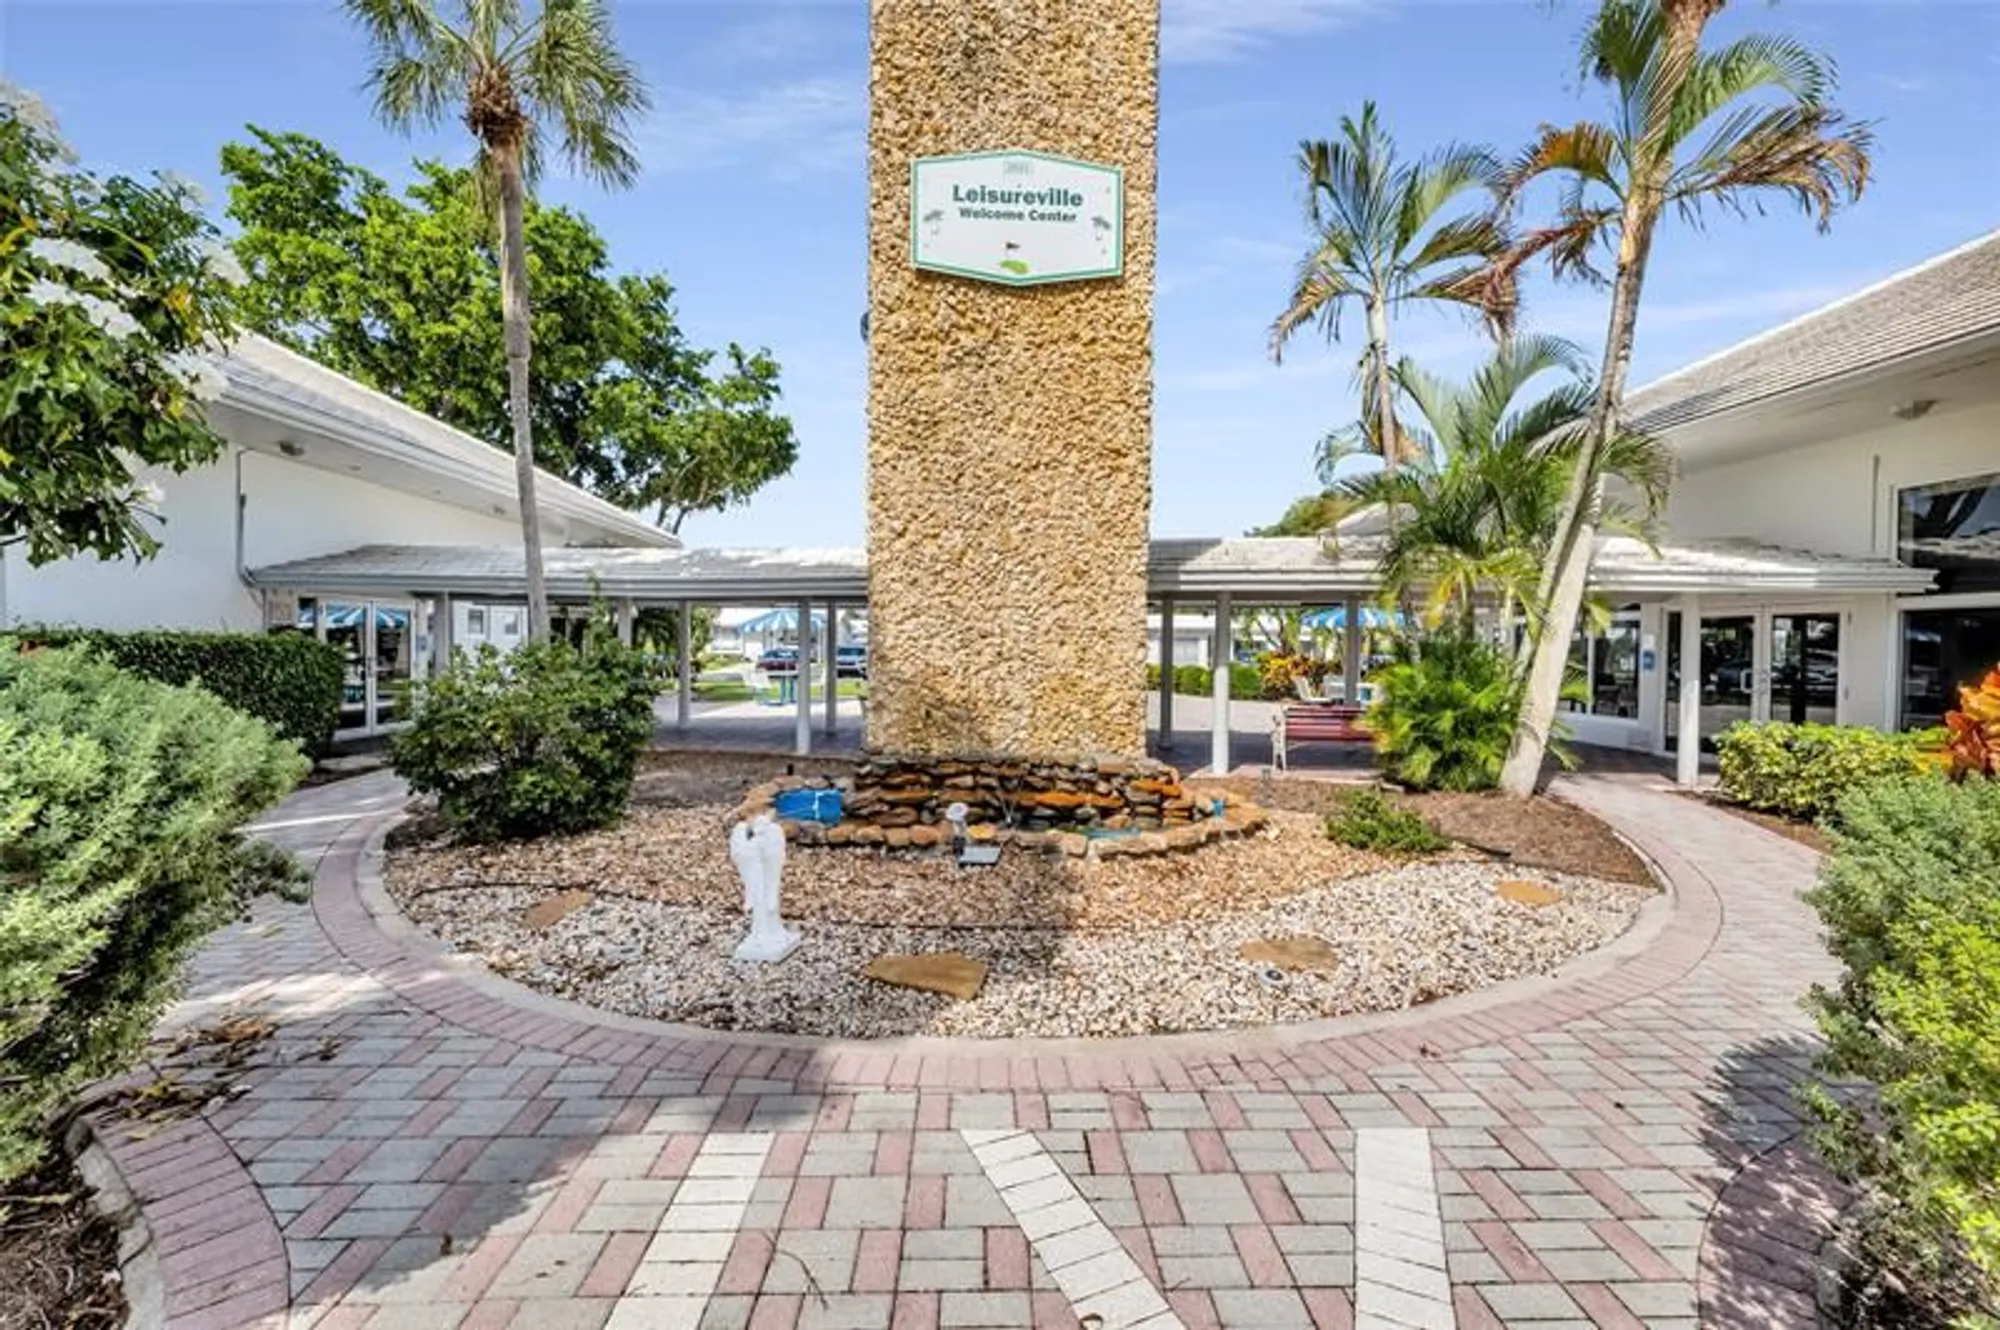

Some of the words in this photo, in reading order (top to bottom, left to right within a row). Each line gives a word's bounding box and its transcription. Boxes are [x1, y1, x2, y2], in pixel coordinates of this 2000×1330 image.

[953, 184, 1083, 207] Leisureville
[959, 207, 1024, 221] Welcome
[1029, 209, 1078, 222] Center
